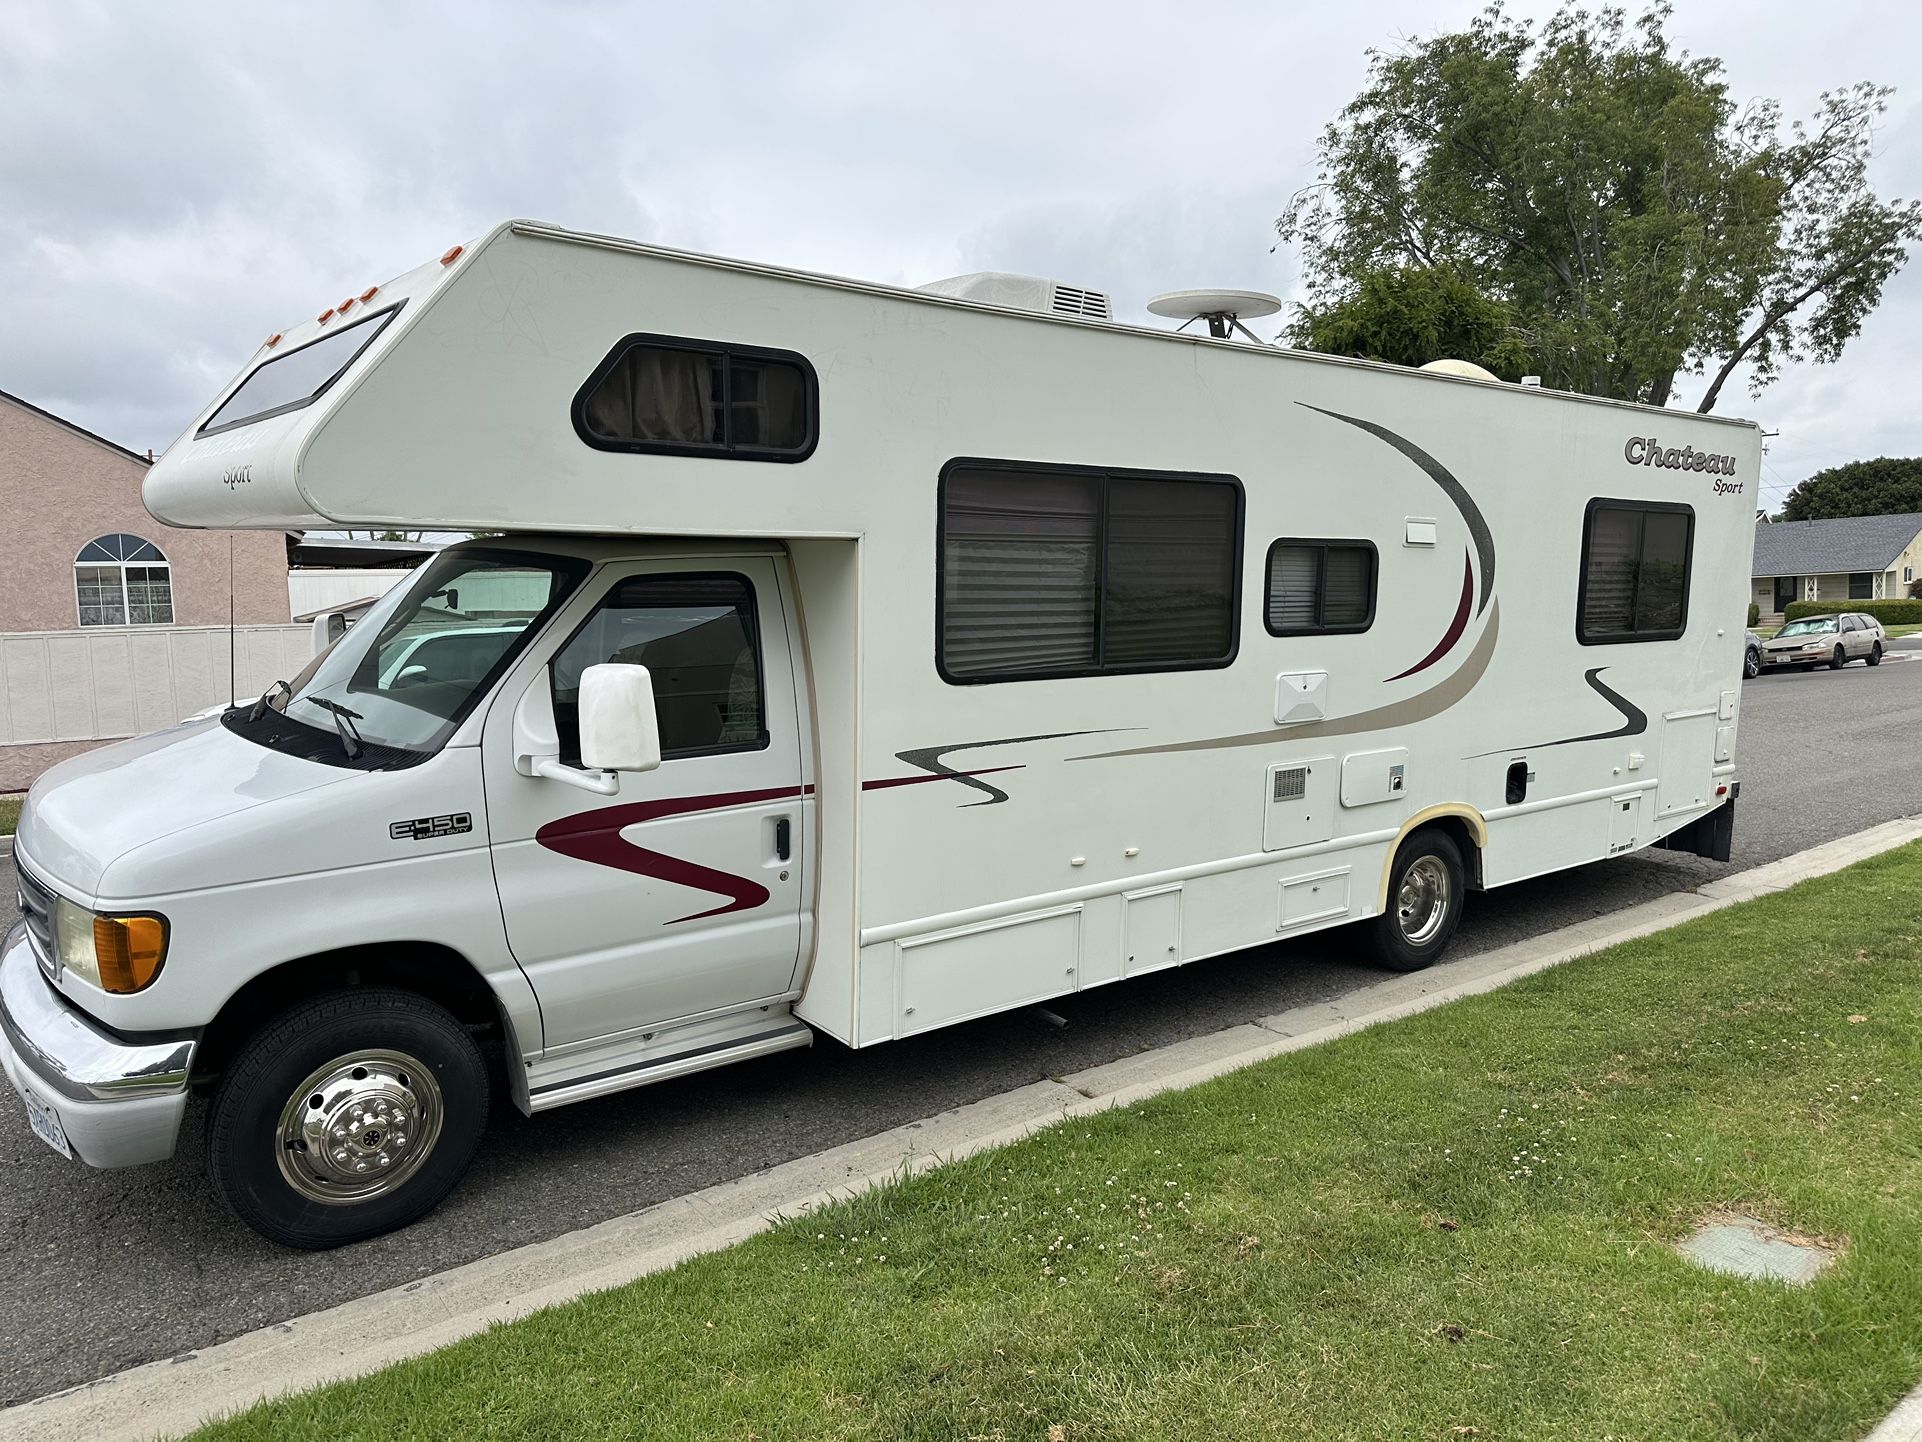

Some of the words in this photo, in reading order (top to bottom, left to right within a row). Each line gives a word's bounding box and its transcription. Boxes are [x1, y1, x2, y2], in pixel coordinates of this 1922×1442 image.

[1625, 436, 1736, 476] Chateau
[1713, 478, 1743, 496] Sport
[417, 831, 445, 839] SUPER
[446, 826, 469, 834] DUTY
